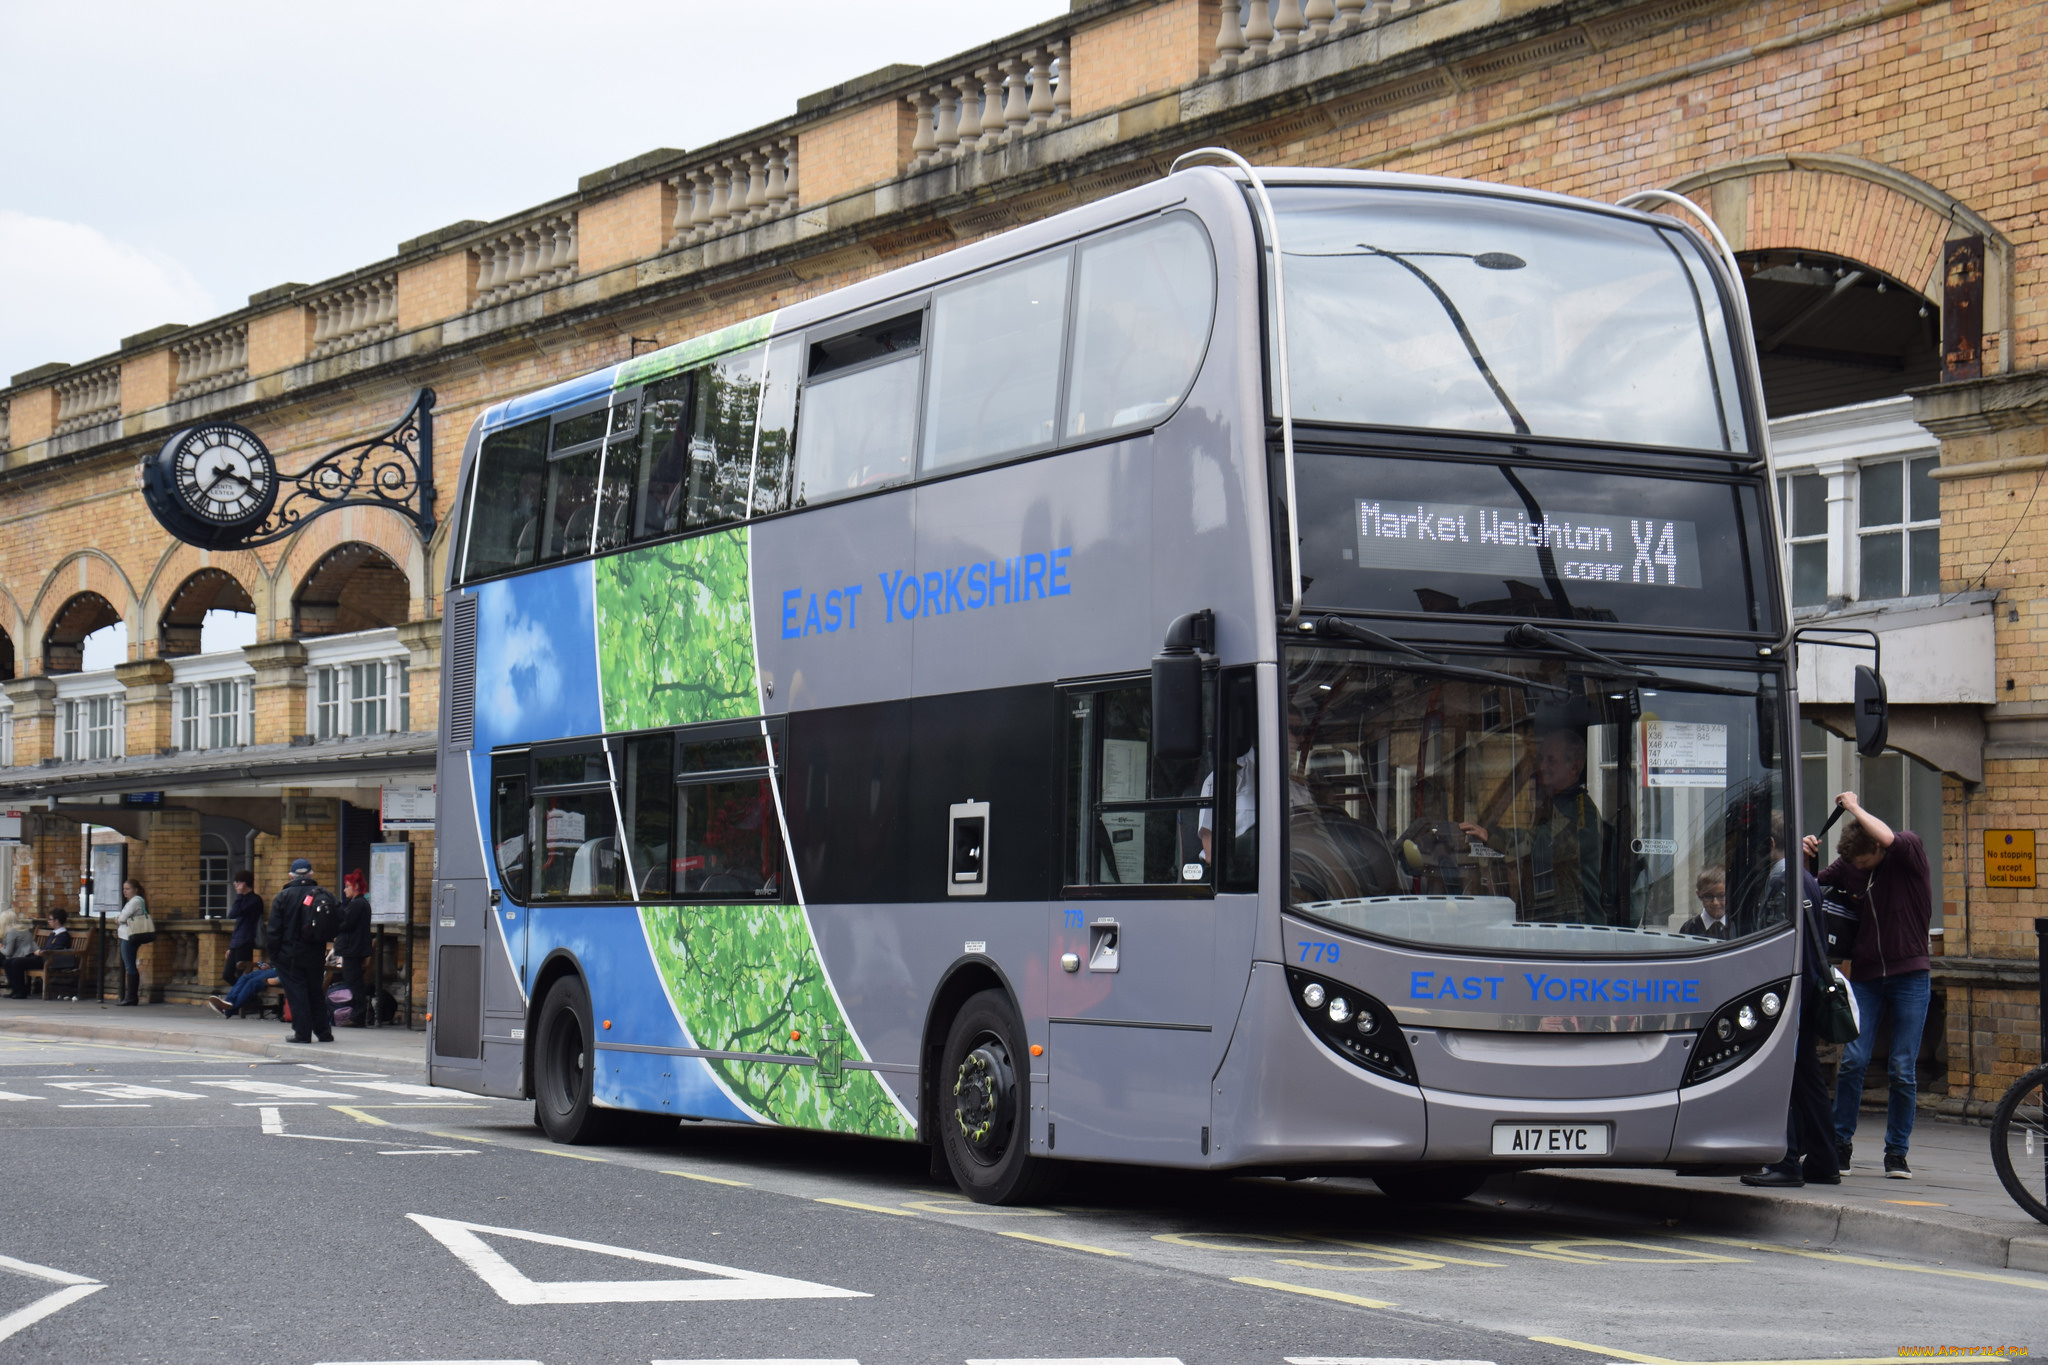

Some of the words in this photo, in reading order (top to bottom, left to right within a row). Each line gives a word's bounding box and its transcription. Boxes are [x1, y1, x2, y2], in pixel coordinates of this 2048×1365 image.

[1361, 501, 1469, 544] Market
[1480, 510, 1613, 552] Weighton
[1631, 519, 1677, 585] X4
[782, 584, 862, 640] EAST
[878, 546, 1072, 623] YORKSHIRE
[1987, 850, 1998, 858] No
[2000, 850, 2032, 860] stopping
[1990, 873, 2007, 882] local
[1997, 864, 2022, 872] except
[1064, 909, 1084, 929] 779
[1297, 942, 1340, 964] 779
[1410, 970, 1504, 1000] EAST
[1522, 973, 1700, 1002] YORKSHIRE
[1512, 1129, 1544, 1151] A17
[1550, 1129, 1588, 1151] EYC
